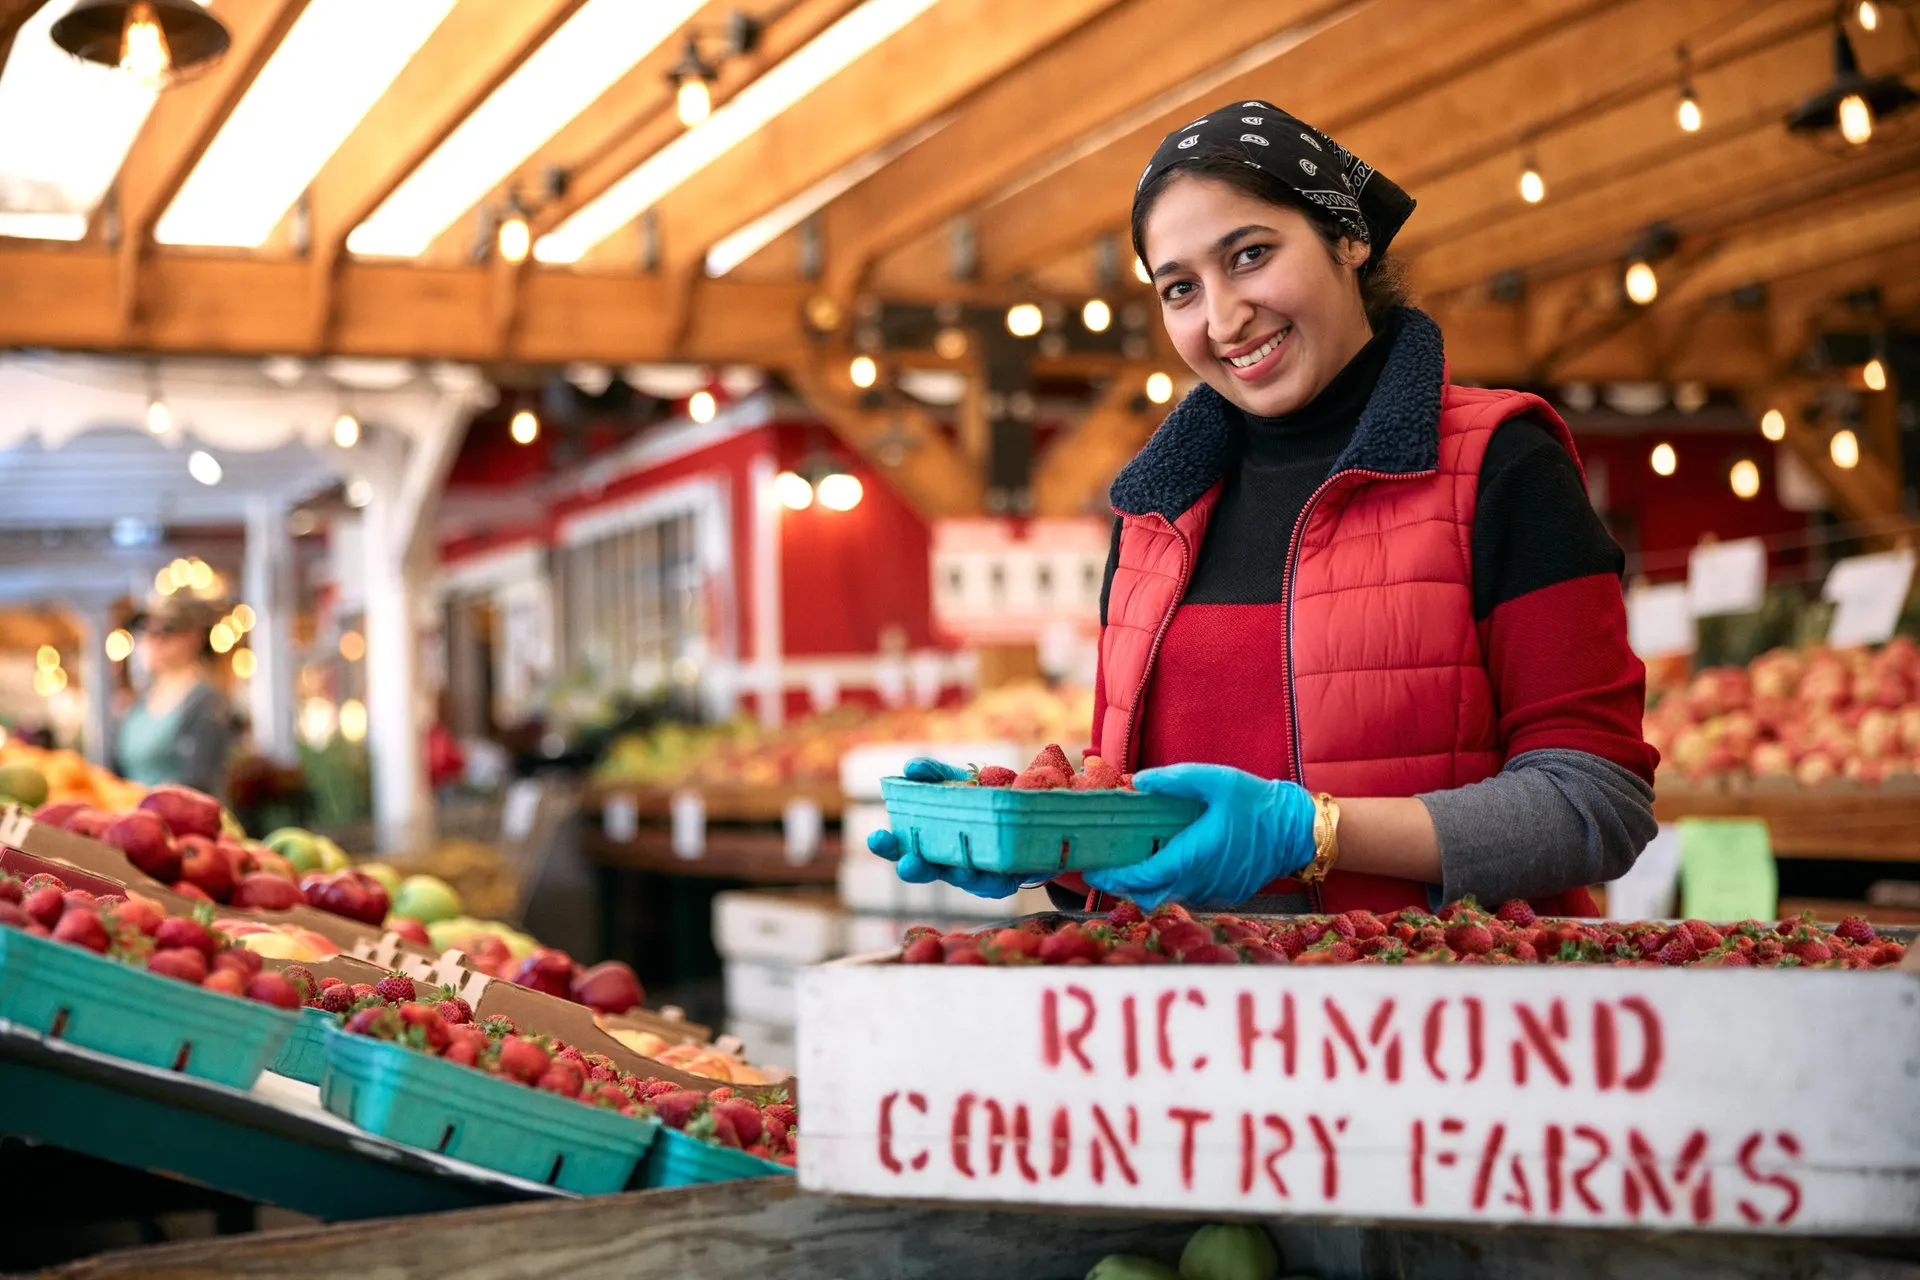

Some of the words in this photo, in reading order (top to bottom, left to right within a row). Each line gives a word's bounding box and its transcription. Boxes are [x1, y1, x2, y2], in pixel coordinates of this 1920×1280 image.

[1038, 984, 1666, 1095] RICHMOND
[875, 1090, 1350, 1203] COUNTRY
[1408, 1115, 1803, 1226] FARMS
